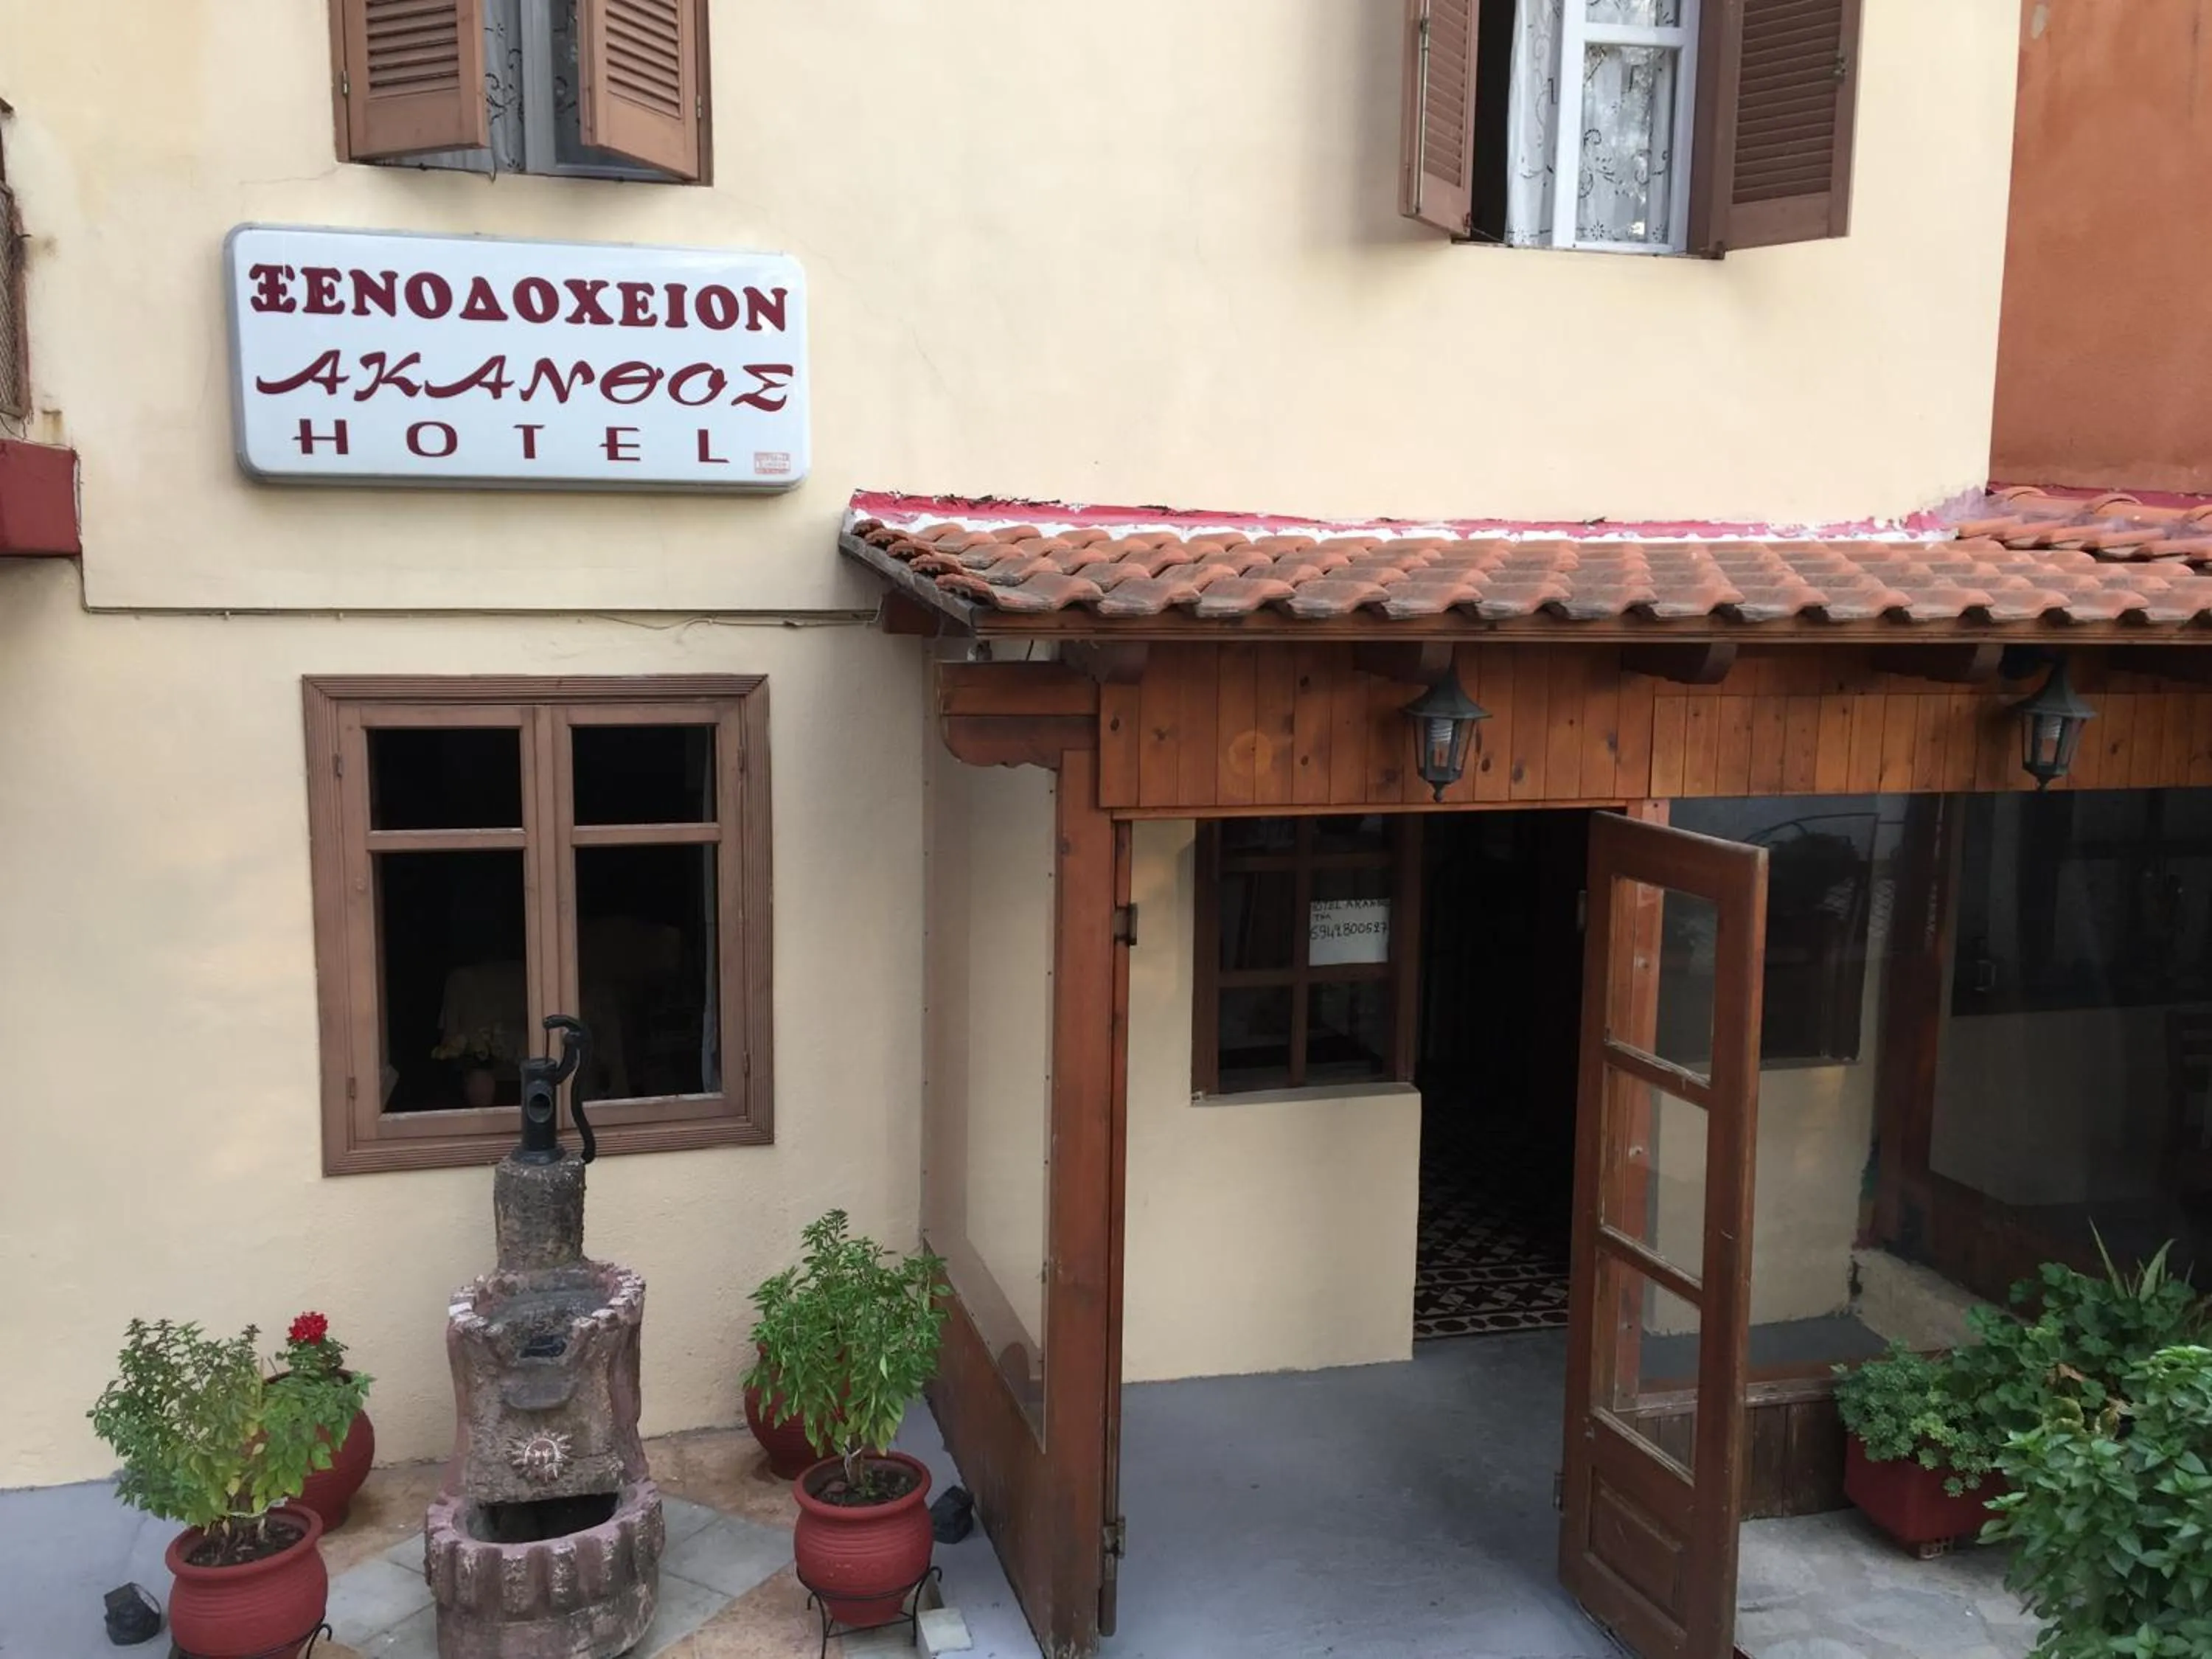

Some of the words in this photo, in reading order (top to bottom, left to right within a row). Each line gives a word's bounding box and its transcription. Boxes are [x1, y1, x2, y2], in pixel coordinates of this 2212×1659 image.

[249, 263, 788, 333] ΞΕΝΟΔΟΧΕΙΟΝ
[255, 349, 794, 412] ΑΚΑΝΘΟΣ
[292, 418, 730, 464] HOTEL
